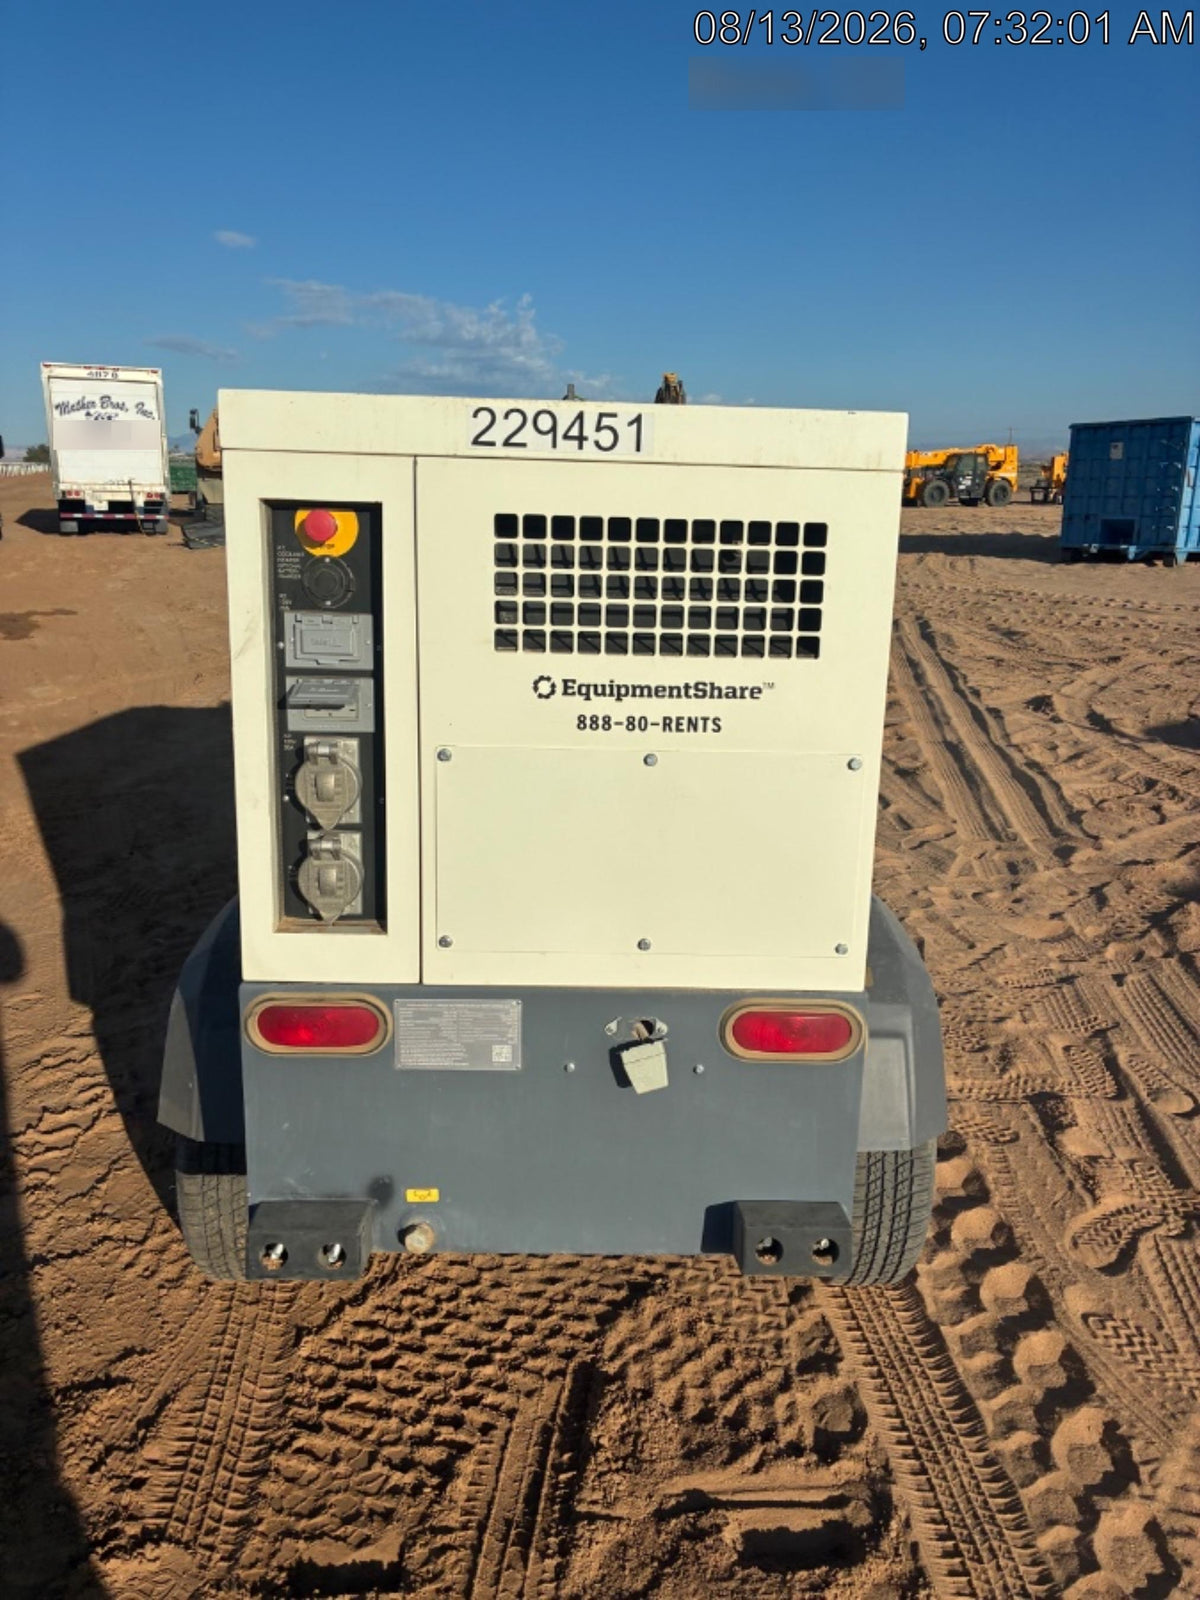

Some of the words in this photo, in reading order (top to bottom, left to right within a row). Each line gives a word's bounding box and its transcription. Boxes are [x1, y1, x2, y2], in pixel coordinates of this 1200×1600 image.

[471, 406, 643, 453] 229451
[561, 678, 763, 702] EquipmentShare
[576, 714, 723, 733] 888-80-RENTS
